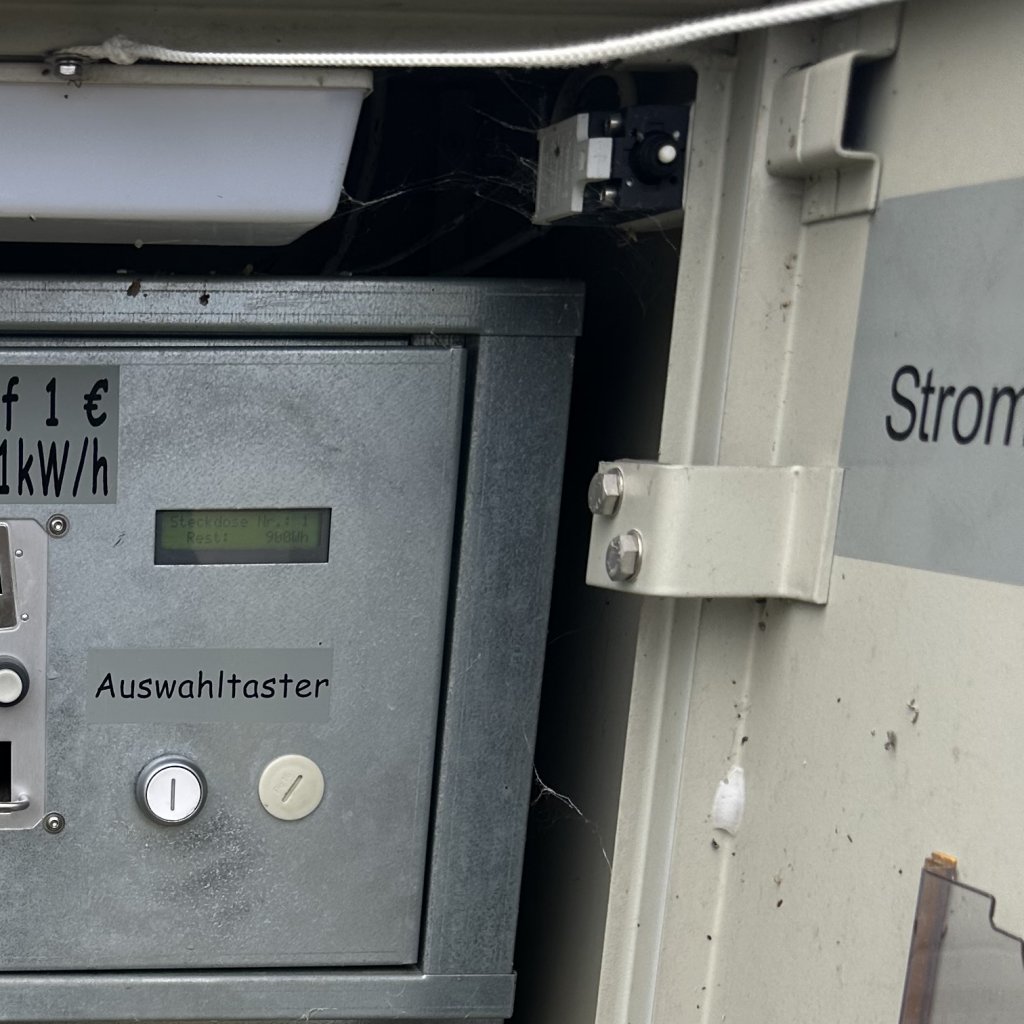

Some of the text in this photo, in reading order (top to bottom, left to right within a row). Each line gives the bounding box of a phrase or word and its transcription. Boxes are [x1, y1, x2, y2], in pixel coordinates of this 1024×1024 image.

[46, 377, 59, 426] 1
[83, 378, 108, 427] €
[95, 670, 329, 699] Auswahltaster
